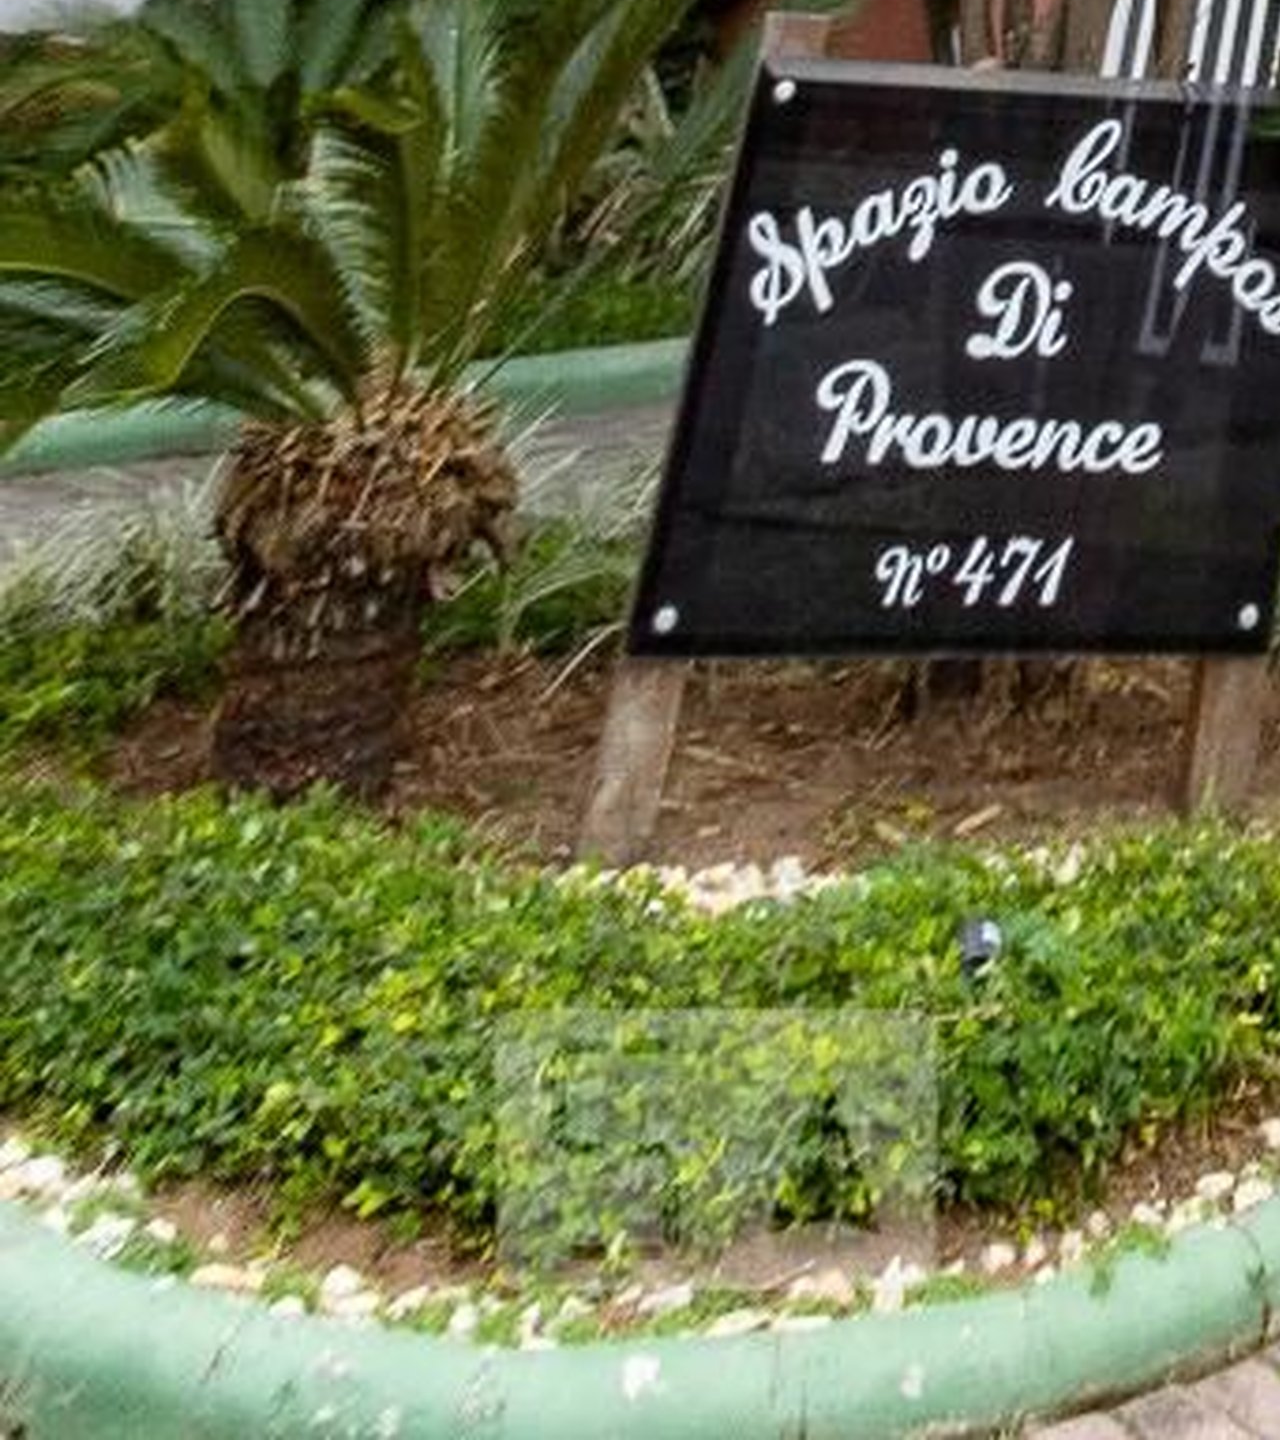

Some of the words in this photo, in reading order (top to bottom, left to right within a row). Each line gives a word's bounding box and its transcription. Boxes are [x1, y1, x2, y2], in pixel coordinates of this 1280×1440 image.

[748, 148, 1014, 326] Spazio
[965, 260, 1073, 360] Di
[815, 359, 1163, 474] Provence
